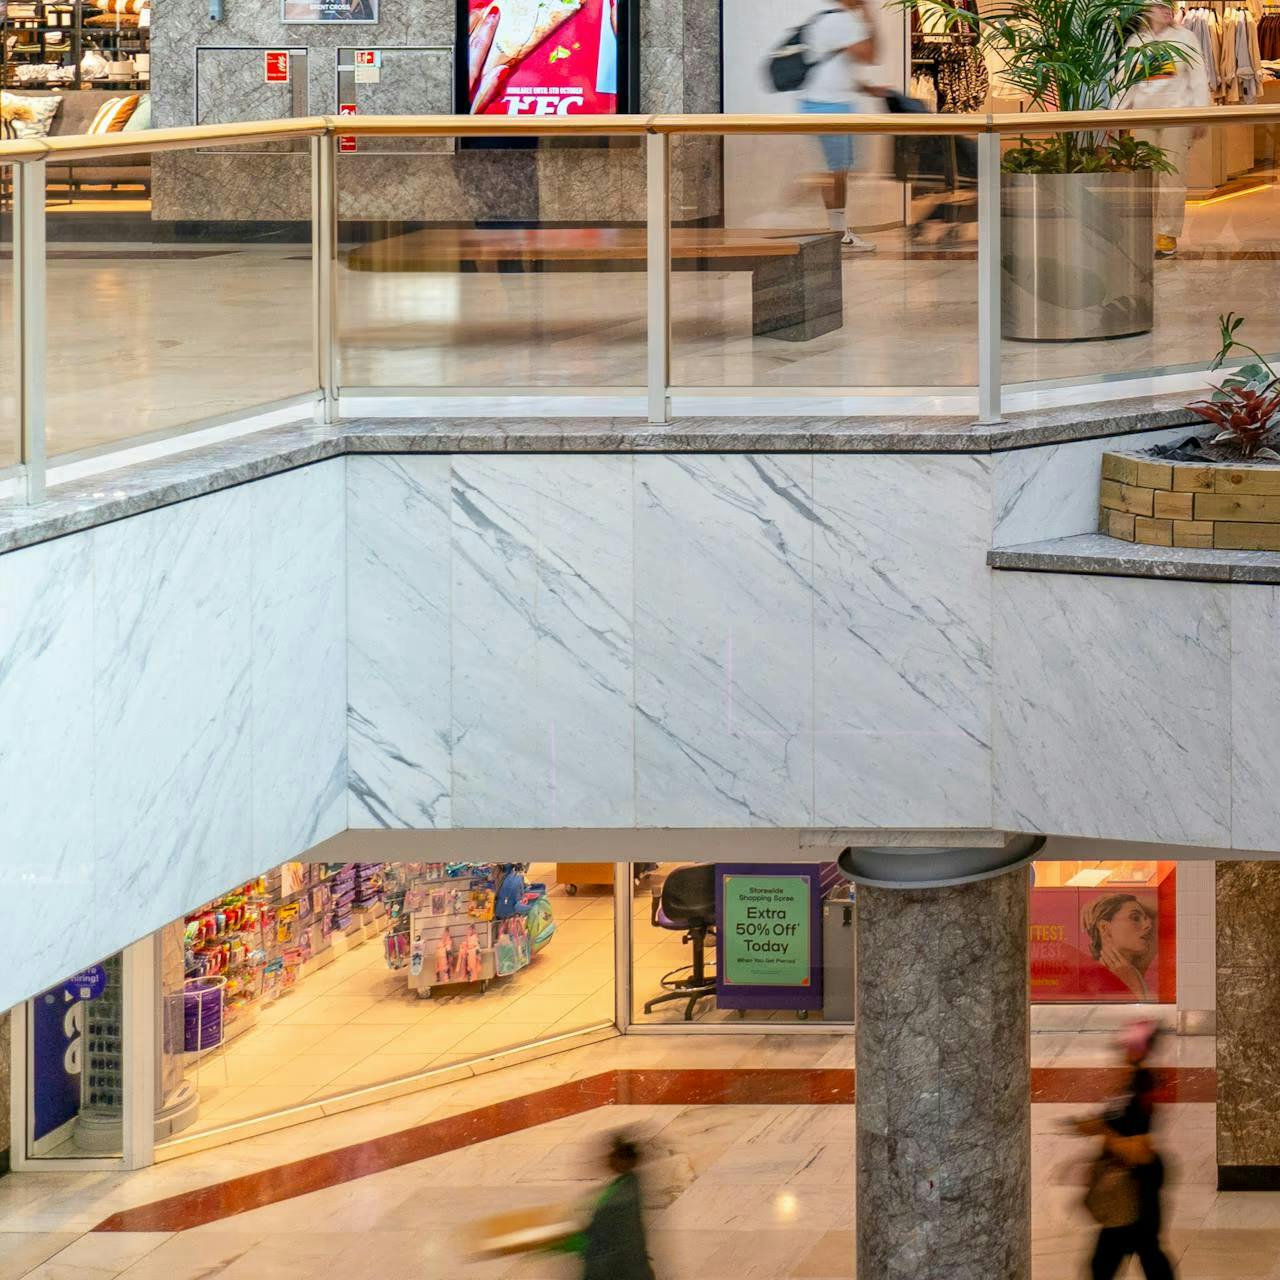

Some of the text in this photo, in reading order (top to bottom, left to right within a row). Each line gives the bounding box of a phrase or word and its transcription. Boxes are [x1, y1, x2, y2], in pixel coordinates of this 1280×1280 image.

[739, 894, 795, 902] Shopping Spree
[747, 906, 786, 920] Extra
[736, 923, 770, 936] 50%
[744, 939, 789, 954] Today
